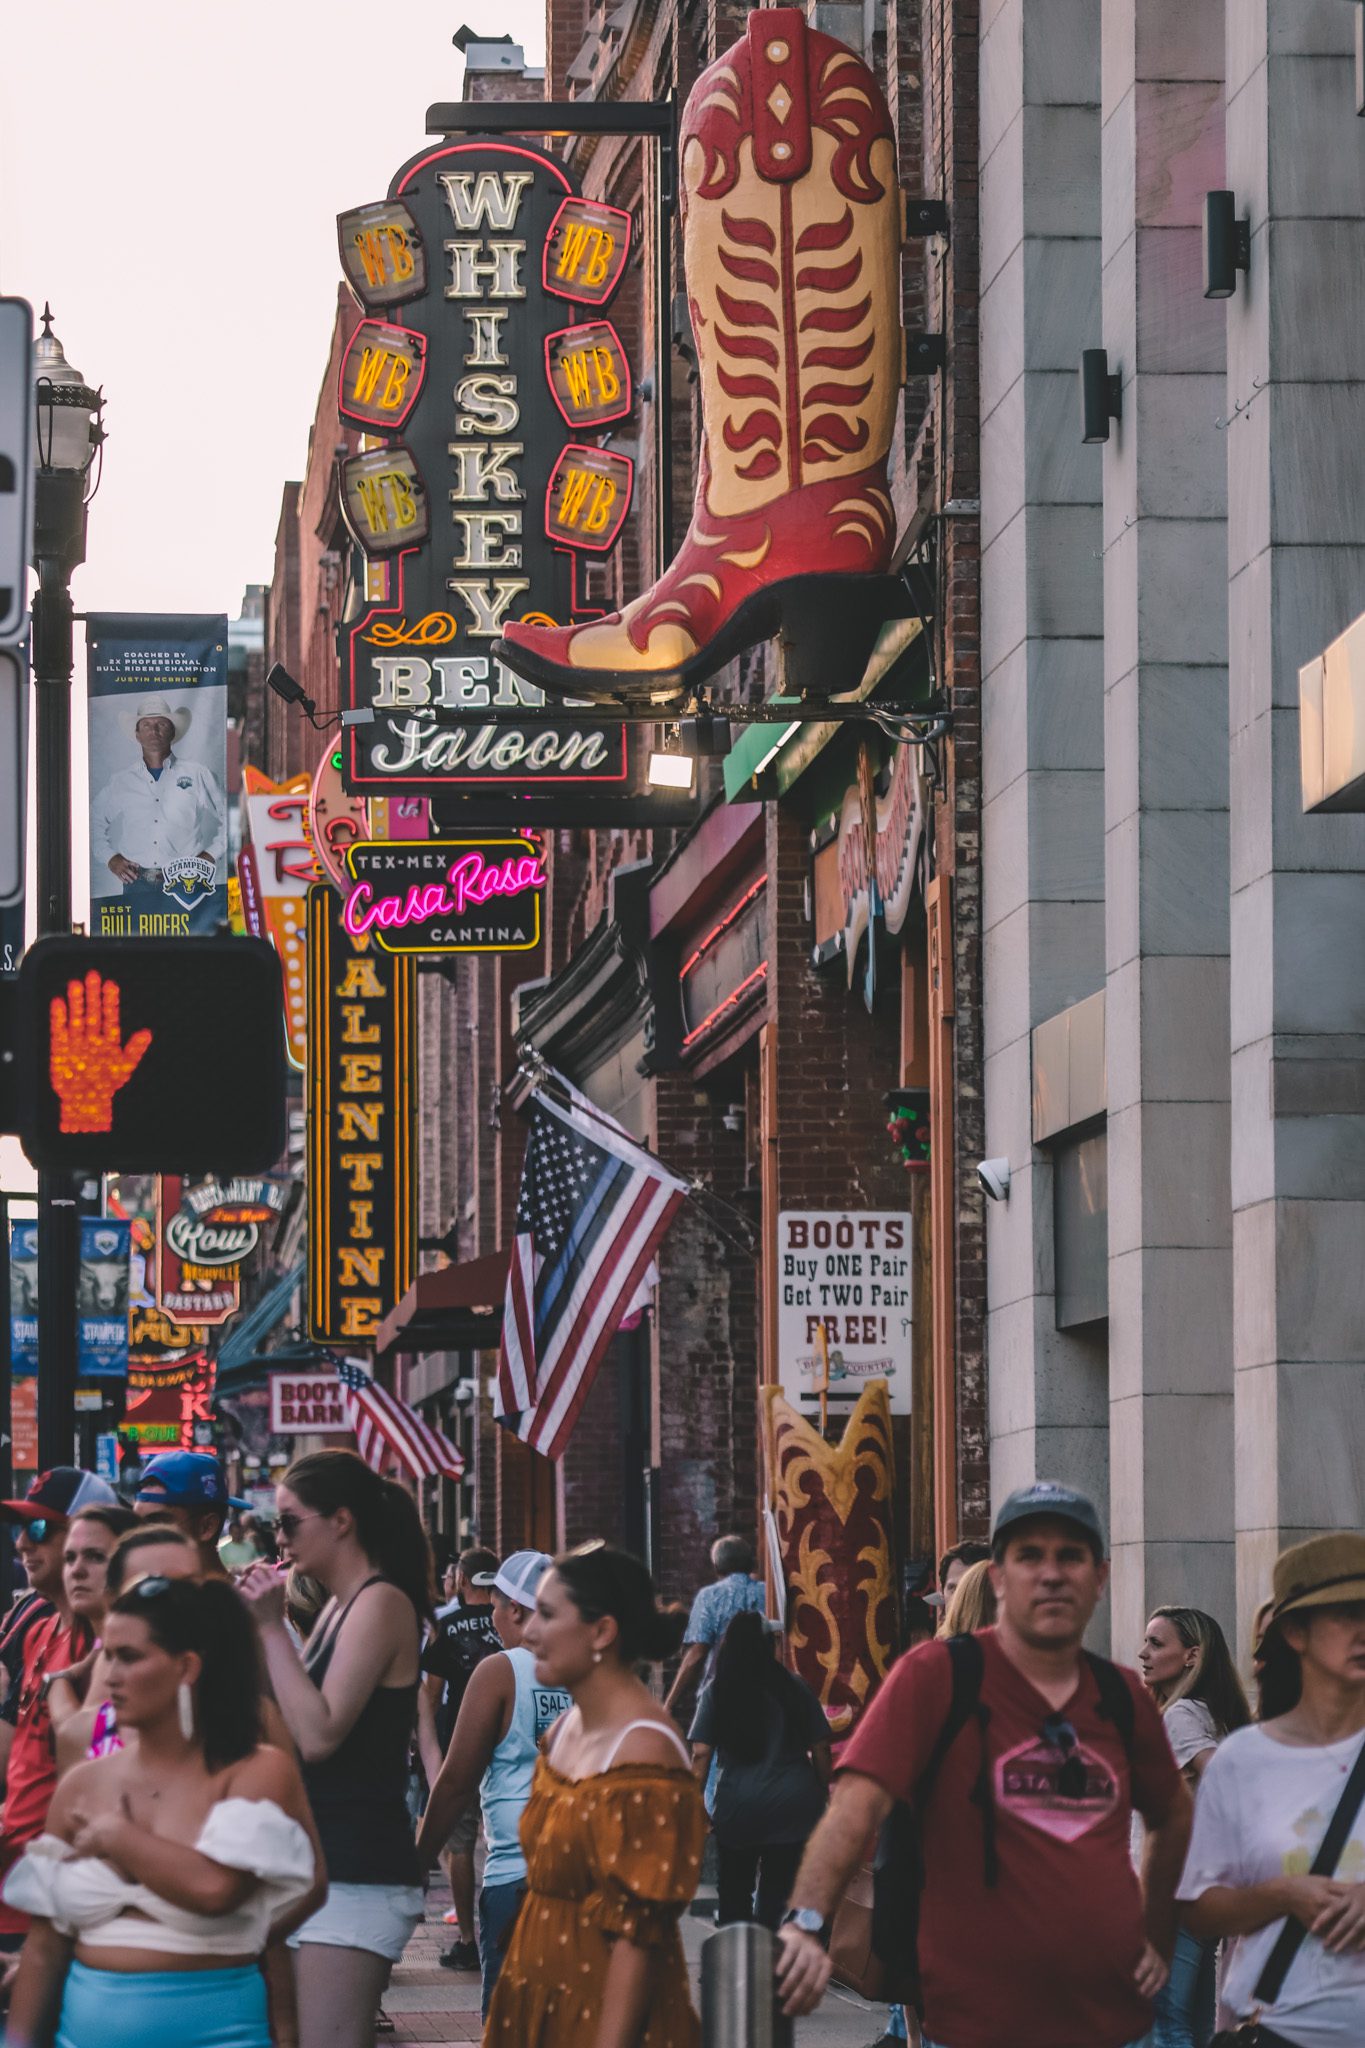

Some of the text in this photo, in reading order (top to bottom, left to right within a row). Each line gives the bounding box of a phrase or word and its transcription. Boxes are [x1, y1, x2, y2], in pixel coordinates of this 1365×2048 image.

[354, 224, 416, 287] WB
[556, 223, 615, 287] WB
[352, 346, 412, 411] WB
[560, 346, 621, 409] WB
[435, 171, 535, 638] WHISKEY
[355, 470, 416, 533] WB
[558, 468, 617, 533] WB
[370, 709, 609, 773] Saloon
[167, 861, 212, 876] STAMPEDE
[358, 855, 447, 869] TEX-MEX
[343, 852, 546, 936] Casa Rosa
[101, 905, 132, 913] BEST
[429, 927, 526, 942] CANTINA
[787, 1220, 904, 1249] BOOTS
[784, 1254, 908, 1282] Buy ONE Pair
[784, 1285, 909, 1307] Get TWO Pair
[806, 1315, 887, 1345] FREE!
[846, 1359, 893, 1373] COUNTRY
[281, 1382, 341, 1402] BOOT
[281, 1404, 344, 1424] BARN
[447, 1616, 490, 1637] AMER
